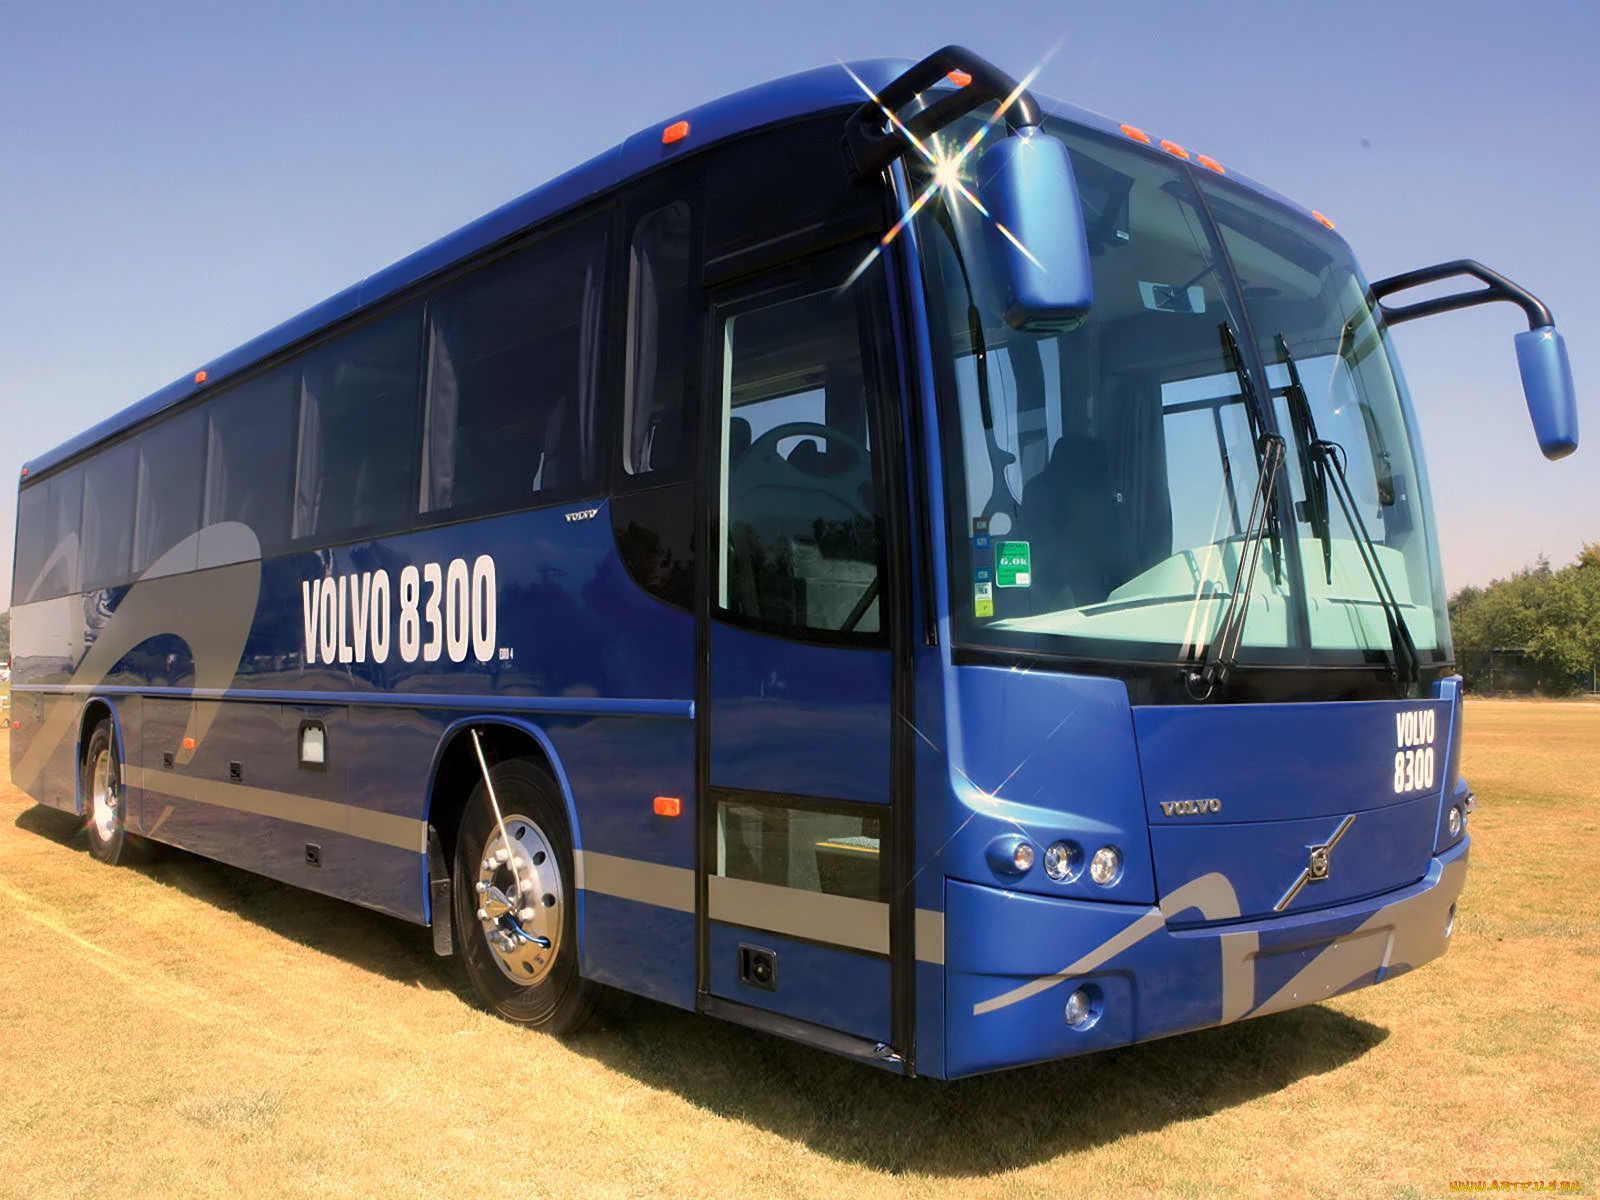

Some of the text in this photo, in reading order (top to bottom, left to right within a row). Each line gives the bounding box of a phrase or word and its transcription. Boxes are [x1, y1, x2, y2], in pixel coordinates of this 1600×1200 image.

[302, 554, 497, 664] VOLVO 8300
[1396, 709, 1435, 748] VOLVO
[1394, 747, 1434, 794] 8300
[1160, 799, 1222, 817] VOLVO
